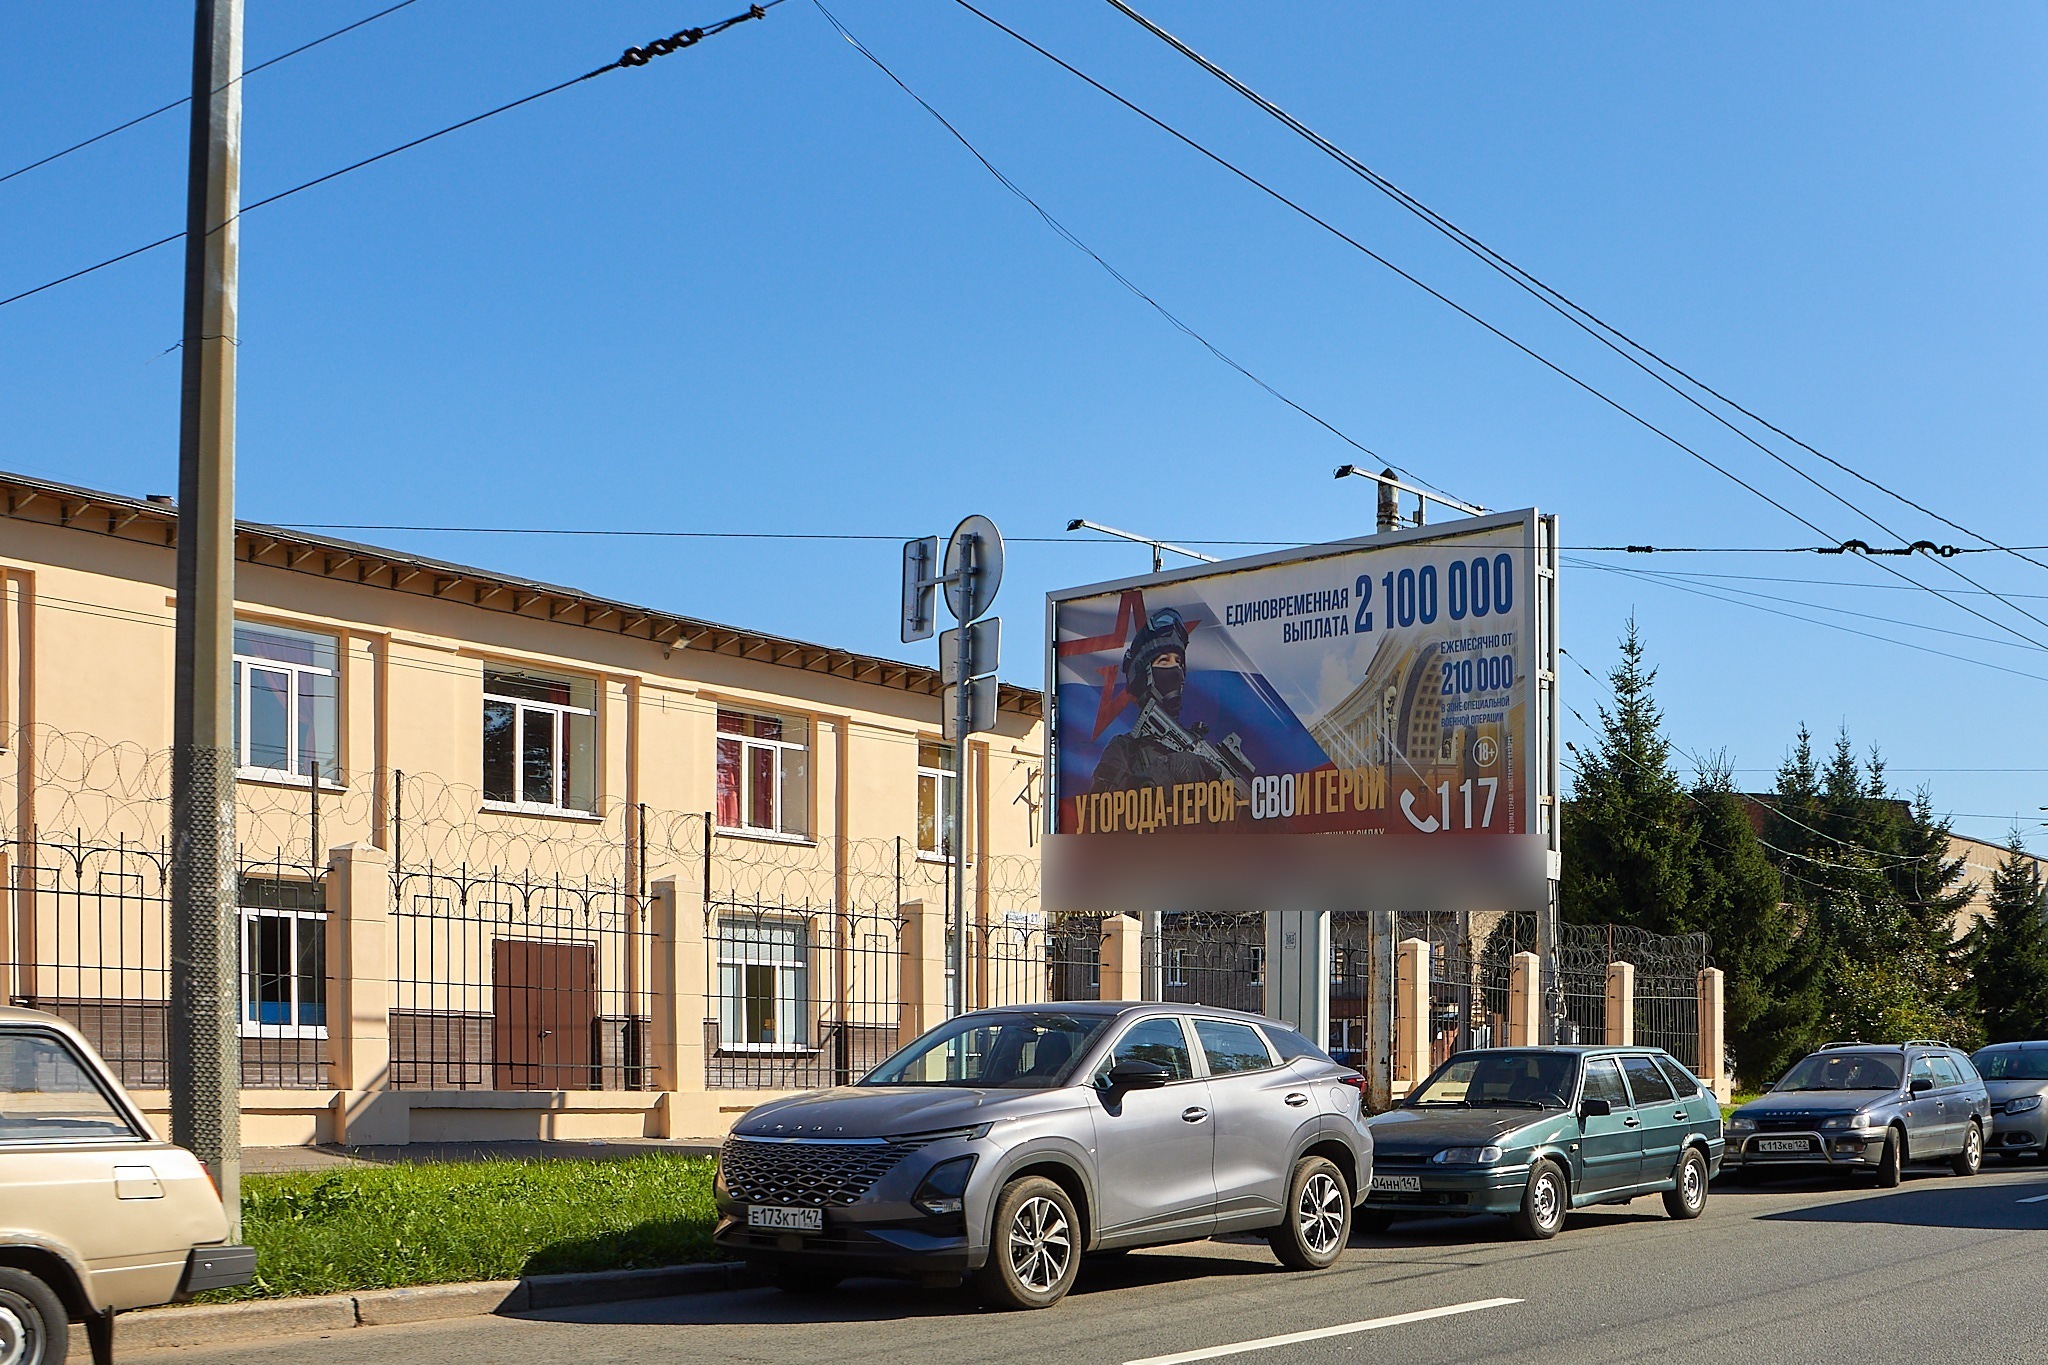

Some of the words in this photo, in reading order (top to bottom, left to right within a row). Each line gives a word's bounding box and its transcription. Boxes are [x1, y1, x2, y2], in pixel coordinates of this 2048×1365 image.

[1354, 574, 1373, 634] 2
[1381, 565, 1438, 629] 100
[1448, 553, 1513, 621] 000
[1226, 588, 1349, 627] ЕДИНОВРЕМЕННАЯ
[1283, 614, 1349, 643] ВЫПЛАТА
[1440, 634, 1500, 654] ЕЖЕМЕСЯЧНО
[1501, 633, 1513, 646] ОТ
[1441, 659, 1473, 696] 210
[1476, 654, 1513, 692] 000
[1441, 703, 1446, 713] В
[1446, 701, 1463, 713] ЗОНЕ
[1463, 696, 1510, 711] СПЕЦИАЛЬНОЙ
[1441, 714, 1470, 727] ВОЕННОЙ
[1470, 712, 1504, 725] ОПЕРАЦИИ
[1477, 742, 1496, 761] 18+
[1075, 794, 1088, 834] У
[1090, 779, 1235, 834] ГОРОДА-ГЕРОЯ
[1251, 771, 1310, 820] СВОИ
[1314, 765, 1385, 814] ГЕРОИ
[1436, 776, 1498, 830] 117
[1371, 1177, 1400, 1190] 04НН
[1401, 1177, 1417, 1188] 147
[752, 1207, 798, 1226] Е173КТ
[800, 1209, 819, 1223] 147
